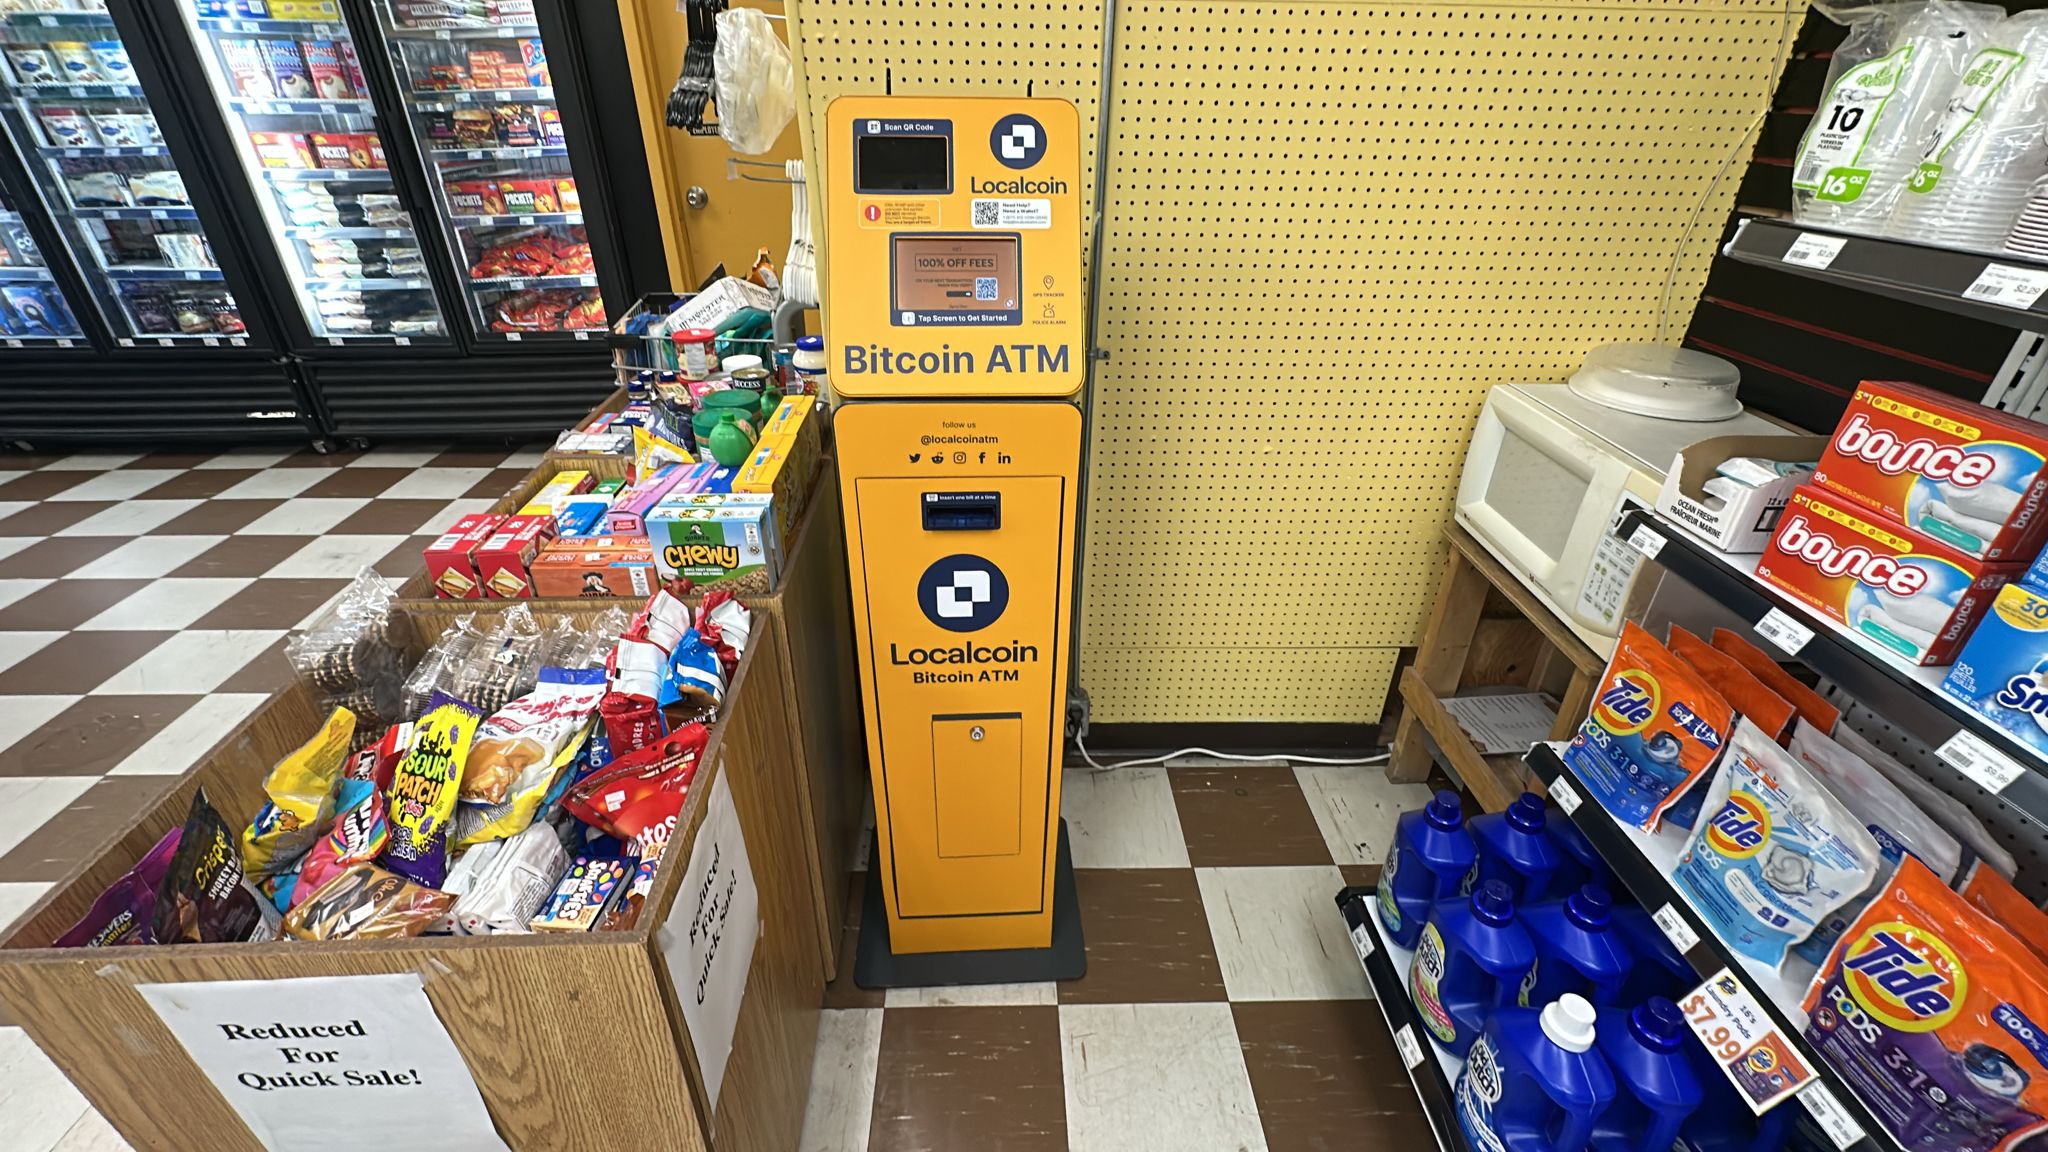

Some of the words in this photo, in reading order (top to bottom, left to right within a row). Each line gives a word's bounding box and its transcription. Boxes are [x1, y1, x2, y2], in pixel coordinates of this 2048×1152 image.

[884, 123, 902, 131] Scan
[903, 123, 914, 132] QR
[915, 123, 934, 131] Code
[1827, 105, 1864, 132] 10
[971, 176, 1067, 194] Localcoin
[1822, 175, 1847, 195] 16
[918, 258, 945, 268] 100%
[947, 258, 967, 268] OFF
[969, 258, 994, 268] FEES
[688, 294, 727, 322] MONSTER
[918, 315, 931, 323] Tap
[932, 315, 957, 323] Screen
[982, 314, 1008, 322] Started
[844, 344, 974, 374] Bitcoin
[986, 344, 1069, 374] ATM
[942, 421, 966, 429] follow
[920, 435, 999, 446] @localcoinatm
[1836, 414, 1996, 488] bounce
[1815, 472, 1827, 483] 80
[1677, 499, 1696, 514] OCEAN
[1699, 521, 1722, 539] MARINE
[664, 544, 740, 570] CHEWY
[1777, 515, 1928, 598] bounce
[1758, 566, 1771, 577] 80
[1943, 598, 1975, 641] bounce
[890, 640, 1038, 665] Localcoin
[913, 671, 973, 684] Bitcoin
[978, 670, 1019, 682] ATM
[1958, 662, 1974, 676] 120
[1601, 676, 1653, 726] Tide
[405, 748, 448, 782] SOUR
[396, 772, 443, 807] PATCH
[1708, 800, 1762, 848] Tide
[208, 860, 231, 900] SMOKEY
[219, 871, 240, 900] BACON
[688, 842, 721, 948] Reduced
[701, 891, 720, 943] For
[696, 928, 721, 1006] Quick
[719, 869, 738, 928] Sale!
[1841, 931, 1952, 1017] Tide
[1705, 984, 1732, 1018] Laundry
[1731, 1017, 1752, 1040] Pods
[1827, 984, 1883, 1044] PODS
[217, 1019, 368, 1041] Reduced
[1683, 994, 1742, 1061] $7.99
[1998, 1007, 2041, 1051] 100%
[277, 1047, 340, 1064] For
[237, 1070, 340, 1092] Quick
[343, 1068, 423, 1087] Sale!
